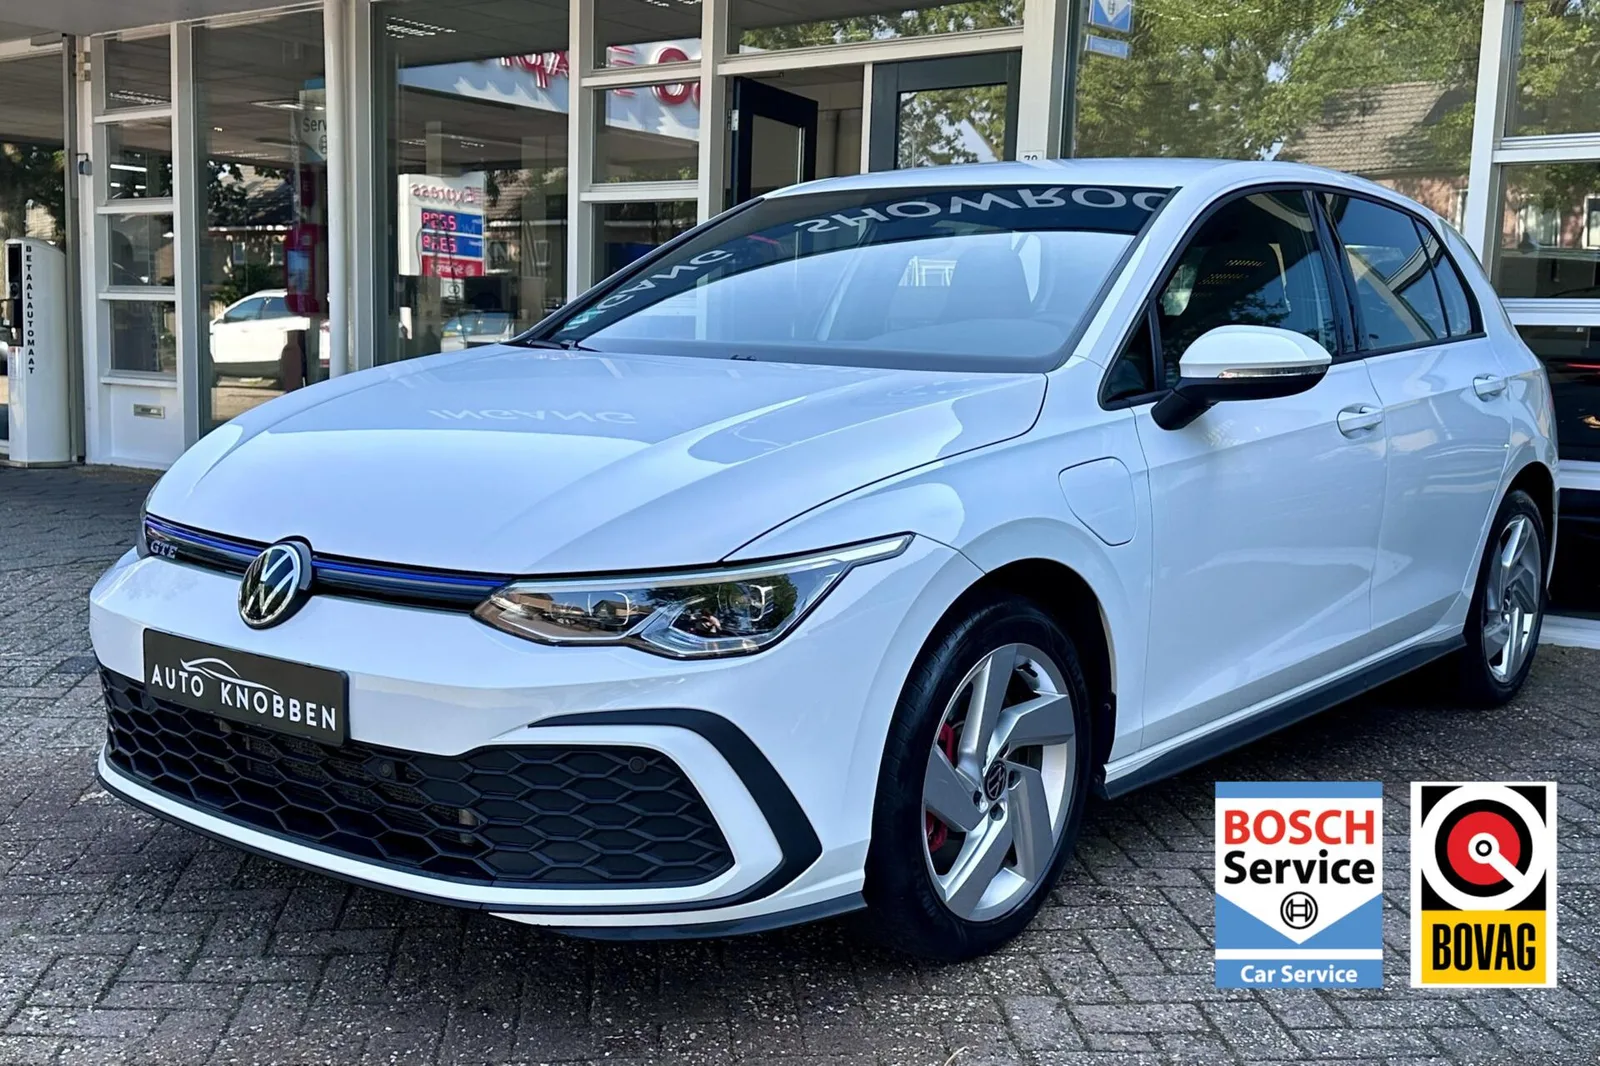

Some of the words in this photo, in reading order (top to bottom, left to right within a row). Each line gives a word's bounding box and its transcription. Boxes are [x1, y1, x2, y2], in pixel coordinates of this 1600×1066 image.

[25, 245, 35, 375] BETAALAUTOMAAT
[150, 540, 178, 559] GTE
[151, 663, 204, 697] AUTO
[220, 681, 337, 732] KNOBBEN
